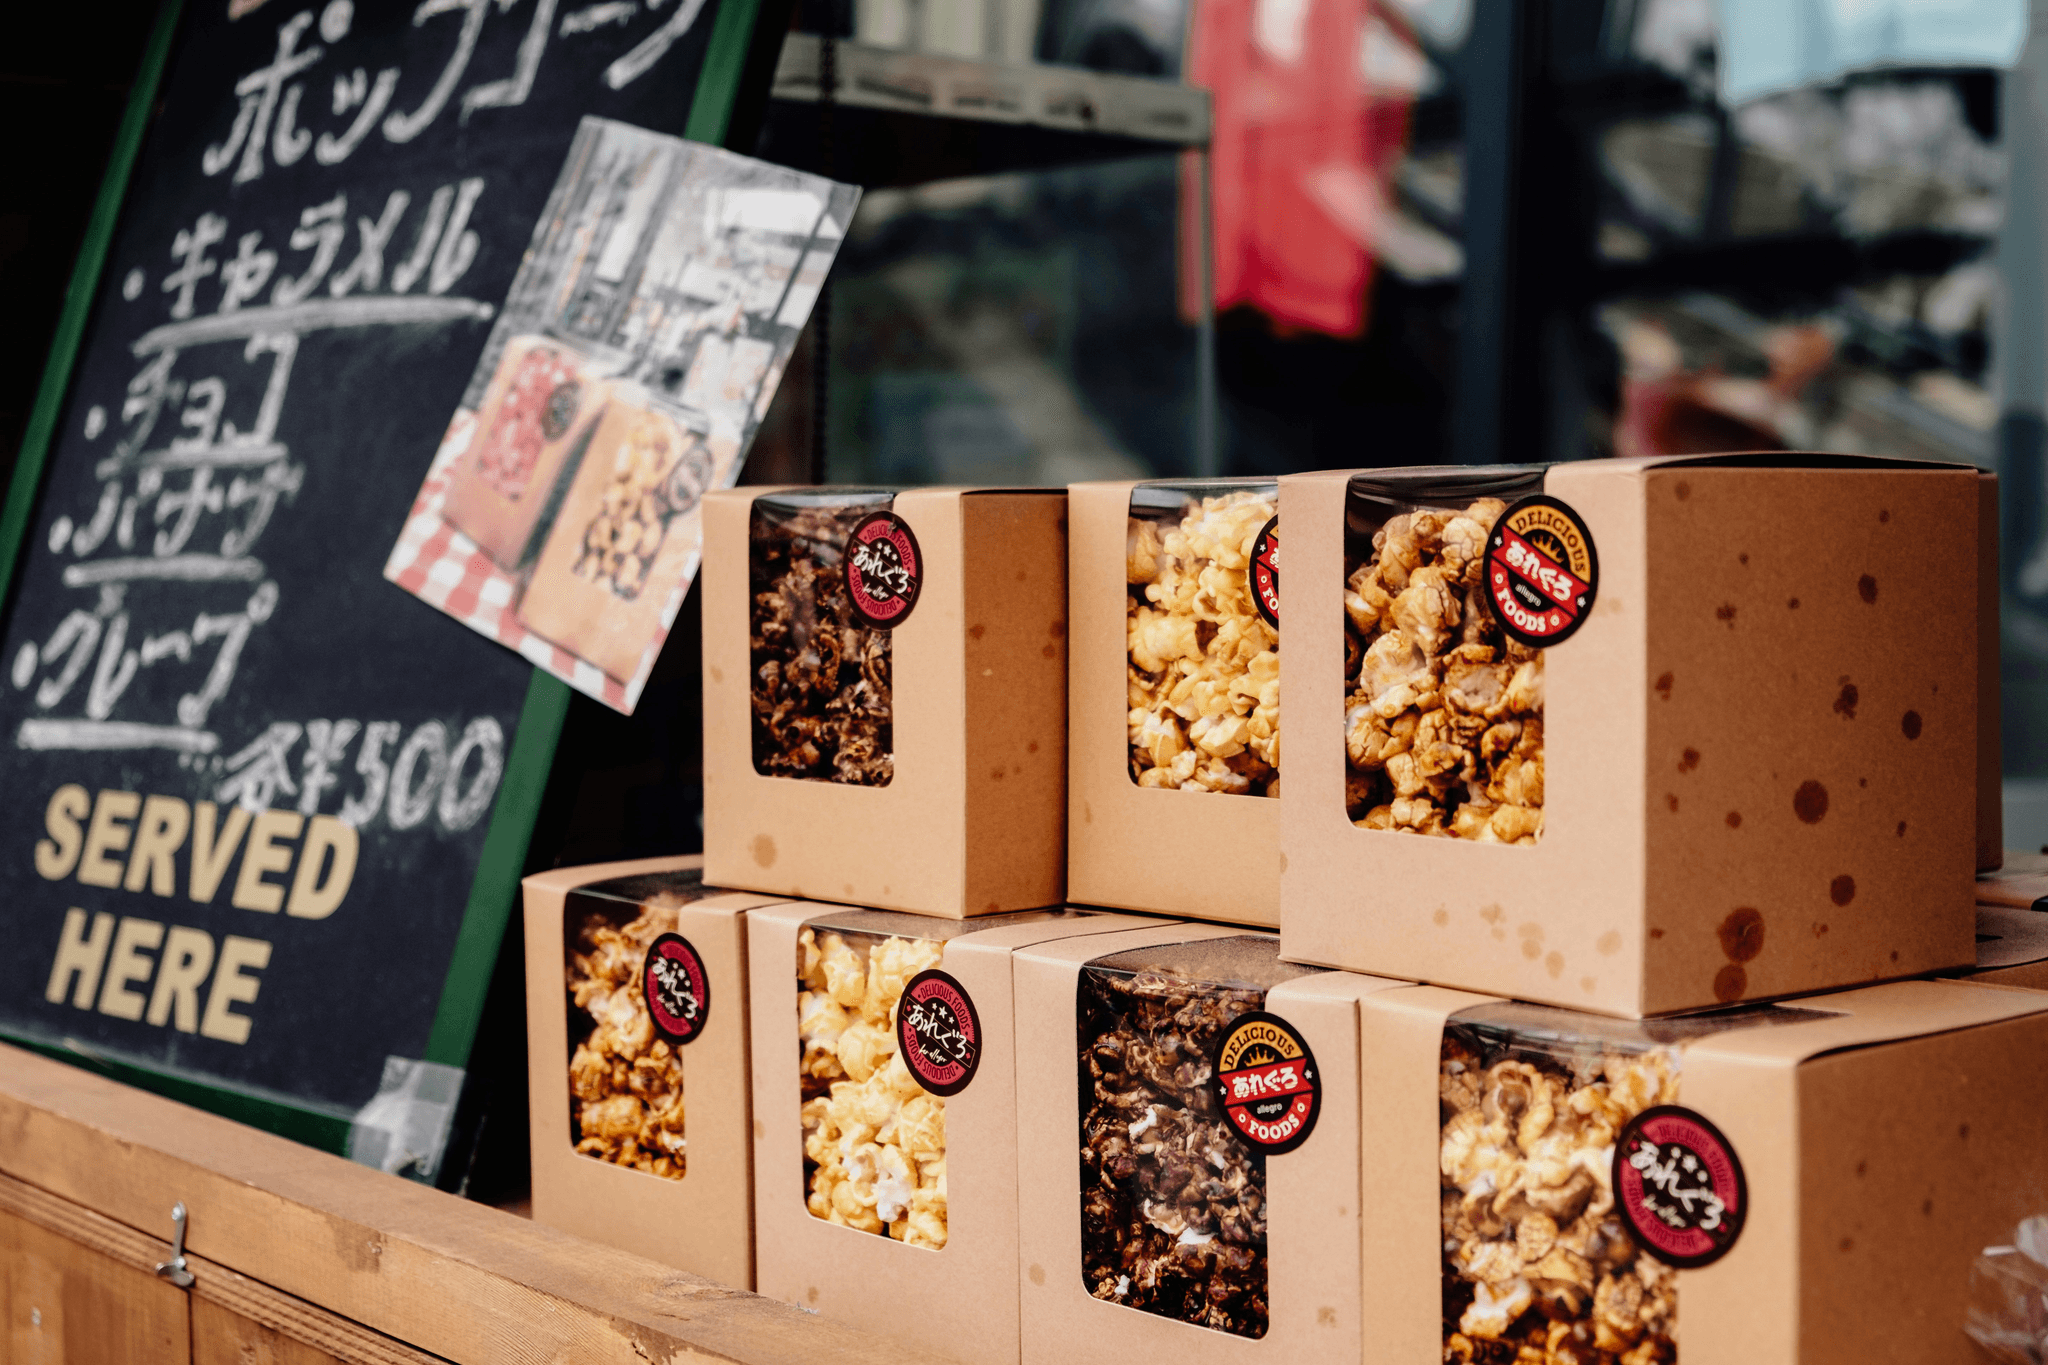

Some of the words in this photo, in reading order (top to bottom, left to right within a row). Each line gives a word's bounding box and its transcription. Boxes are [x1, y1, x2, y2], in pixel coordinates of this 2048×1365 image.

[1515, 510, 1586, 573] DELICIOUS
[853, 544, 909, 594] あれぐろ
[1505, 540, 1574, 602] あれぐろ
[1497, 587, 1546, 633] FOODS
[1514, 583, 1542, 607] allegro
[34, 783, 360, 921] SERVED
[45, 907, 273, 1045] HERE
[908, 1004, 967, 1059] あれぐろ
[951, 996, 970, 1030] FOODS
[1223, 1027, 1295, 1069] DELICIOUS
[1231, 1066, 1299, 1099] あれぐろ
[1248, 1113, 1300, 1140] FOODS
[1256, 1102, 1283, 1115] allegro
